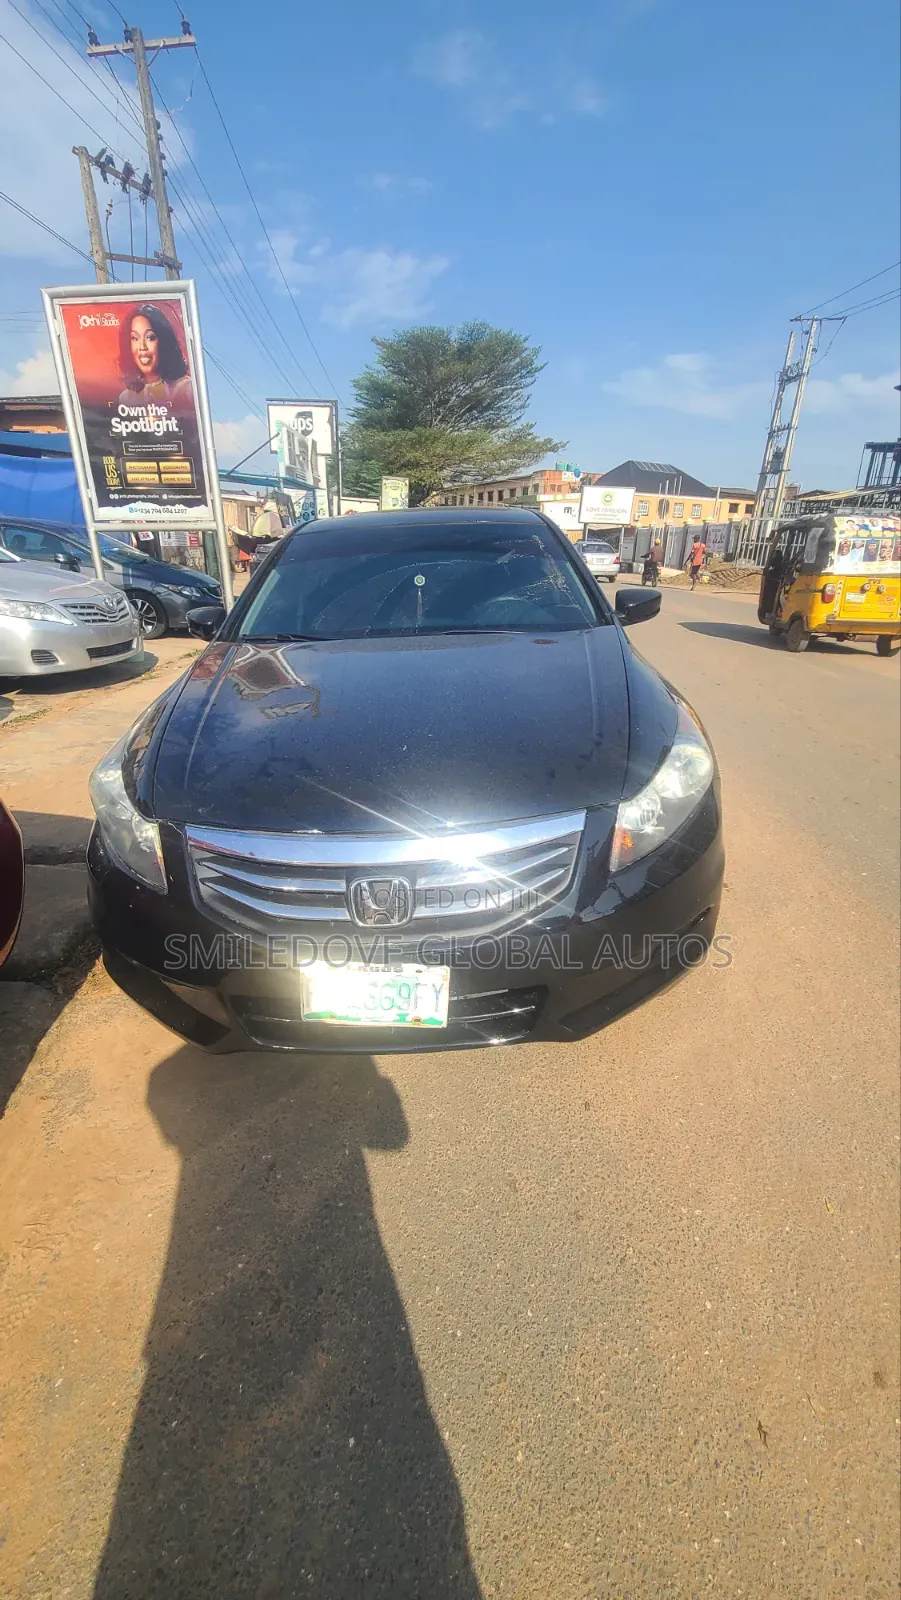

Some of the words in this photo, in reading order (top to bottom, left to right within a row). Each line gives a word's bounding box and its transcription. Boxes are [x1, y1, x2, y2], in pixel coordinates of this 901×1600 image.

[118, 404, 146, 417] Own
[147, 403, 168, 416] the
[111, 416, 179, 436] Spotlight
